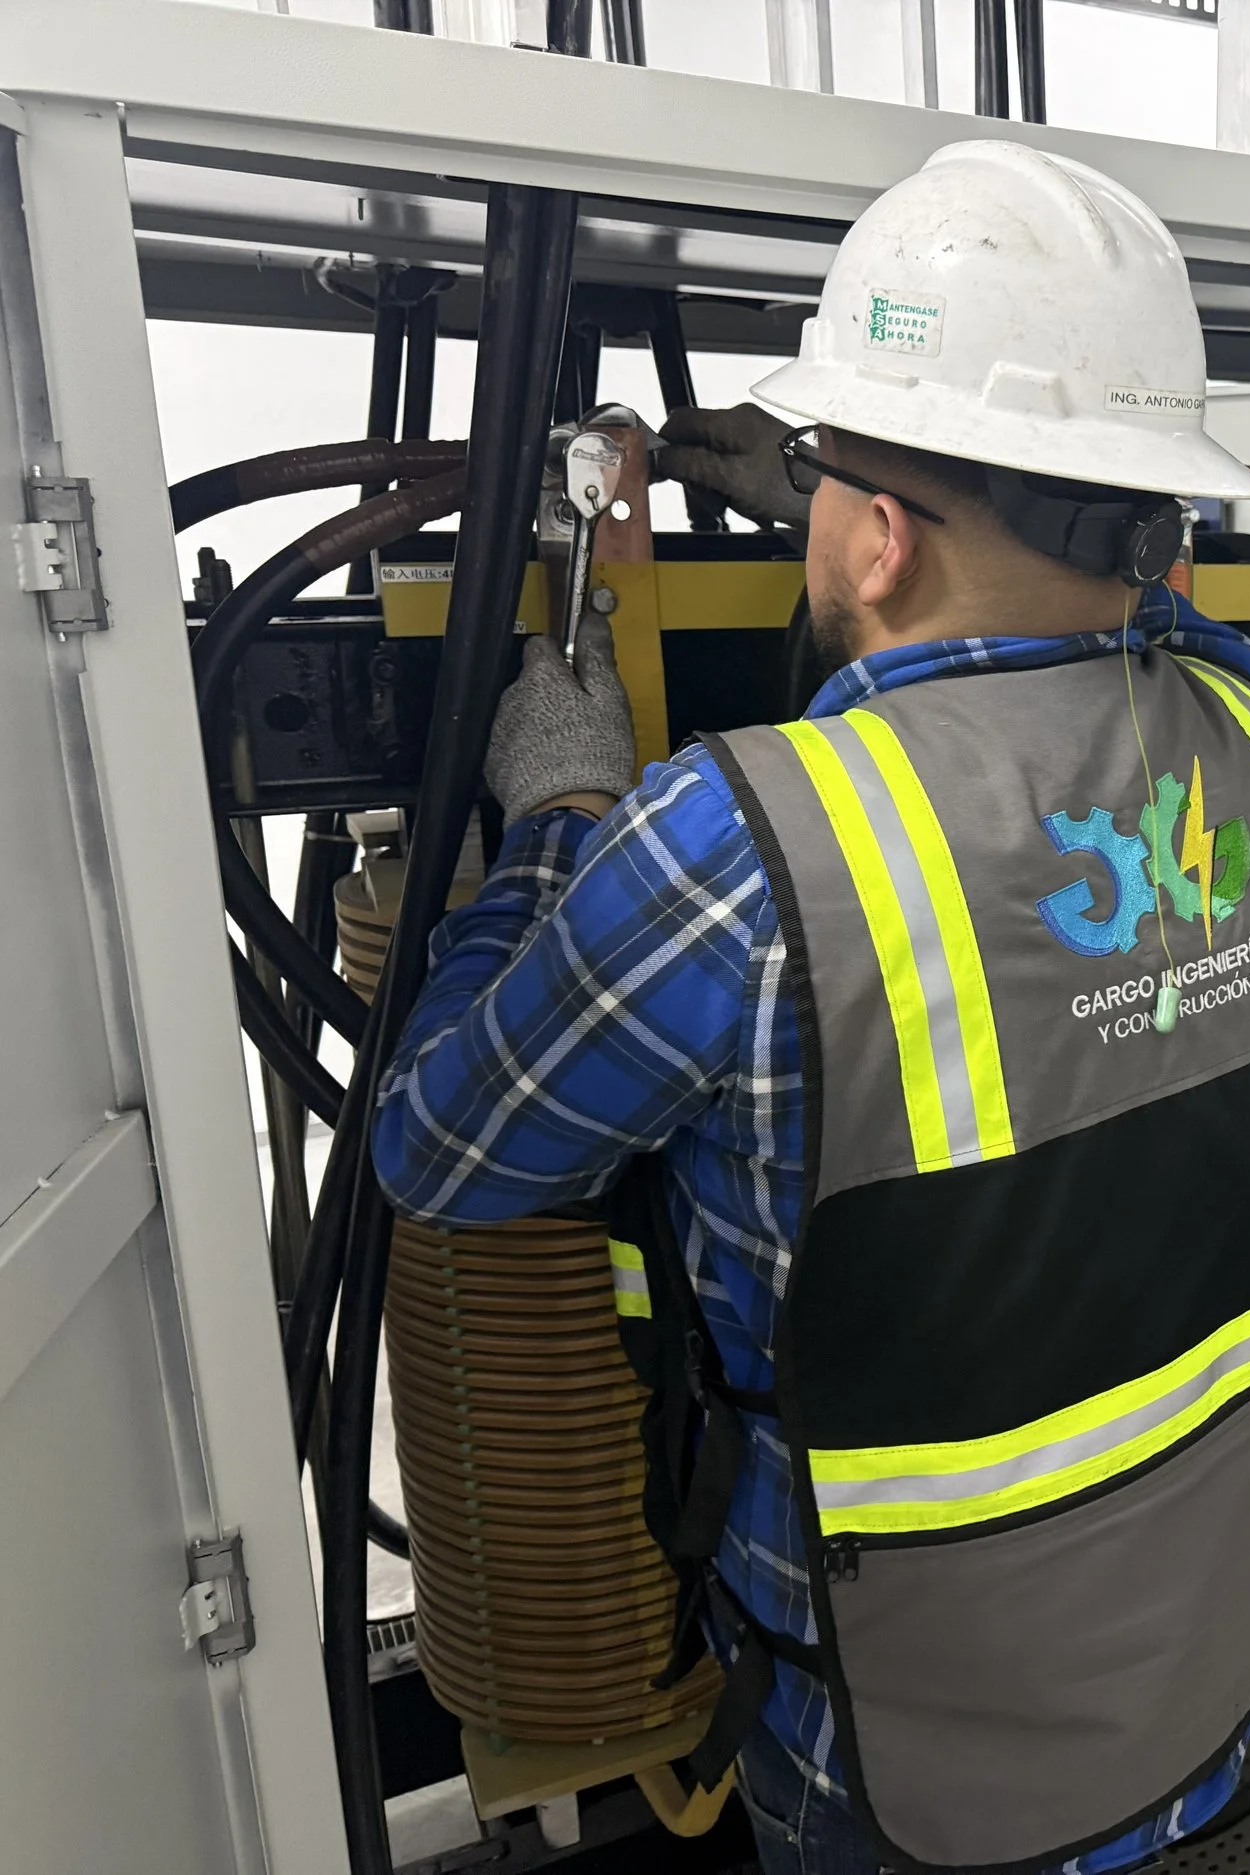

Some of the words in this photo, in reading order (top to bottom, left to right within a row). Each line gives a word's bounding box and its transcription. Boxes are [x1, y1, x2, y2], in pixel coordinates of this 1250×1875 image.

[873, 298, 939, 317] MANTENGASE
[872, 313, 927, 329] SEGURO
[871, 327, 925, 343] AHORA
[1110, 392, 1140, 405] ING.
[1145, 395, 1193, 409] ANTONIO
[1072, 975, 1155, 1018] GARGO
[1098, 1023, 1111, 1044] Y
